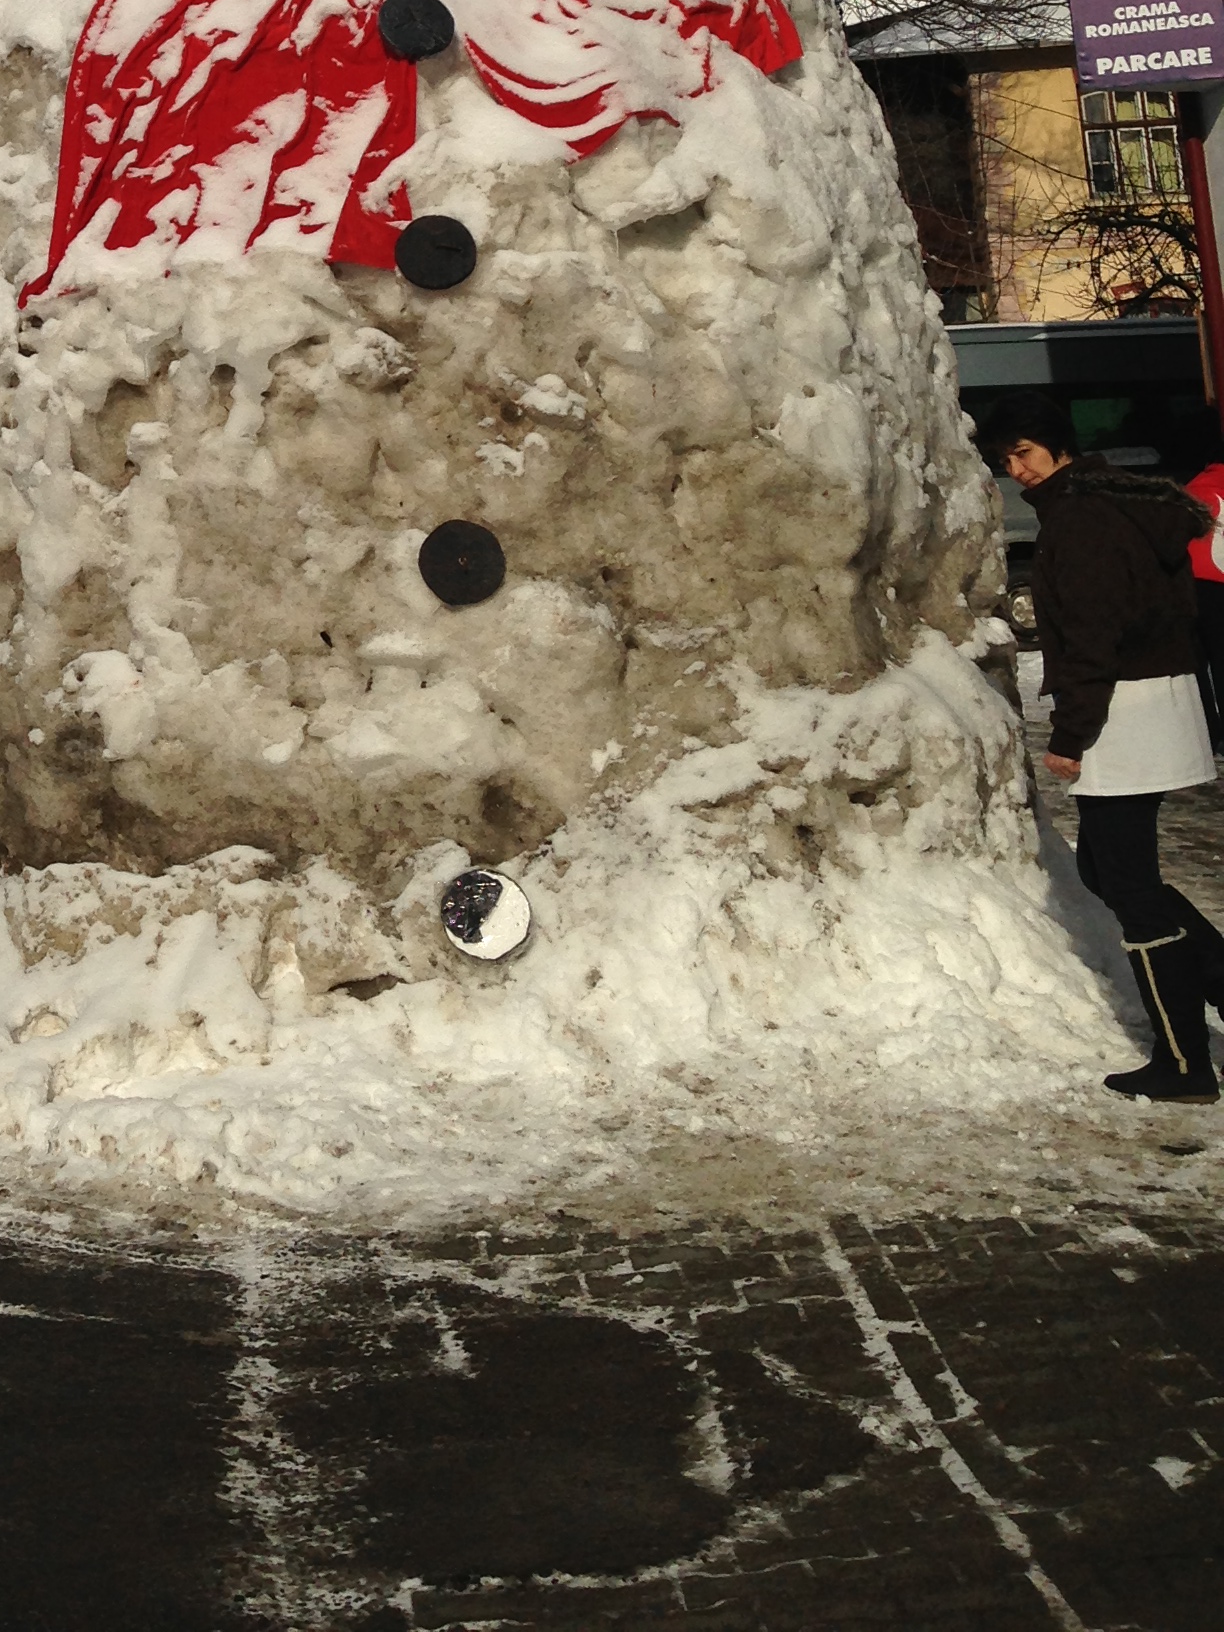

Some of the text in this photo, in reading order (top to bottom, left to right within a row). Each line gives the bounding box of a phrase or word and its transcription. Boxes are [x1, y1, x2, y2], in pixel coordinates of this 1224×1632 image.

[1114, 1, 1181, 20] CRAMA
[1085, 12, 1215, 38] ROMANEASCA
[1096, 46, 1213, 75] PARCARE
